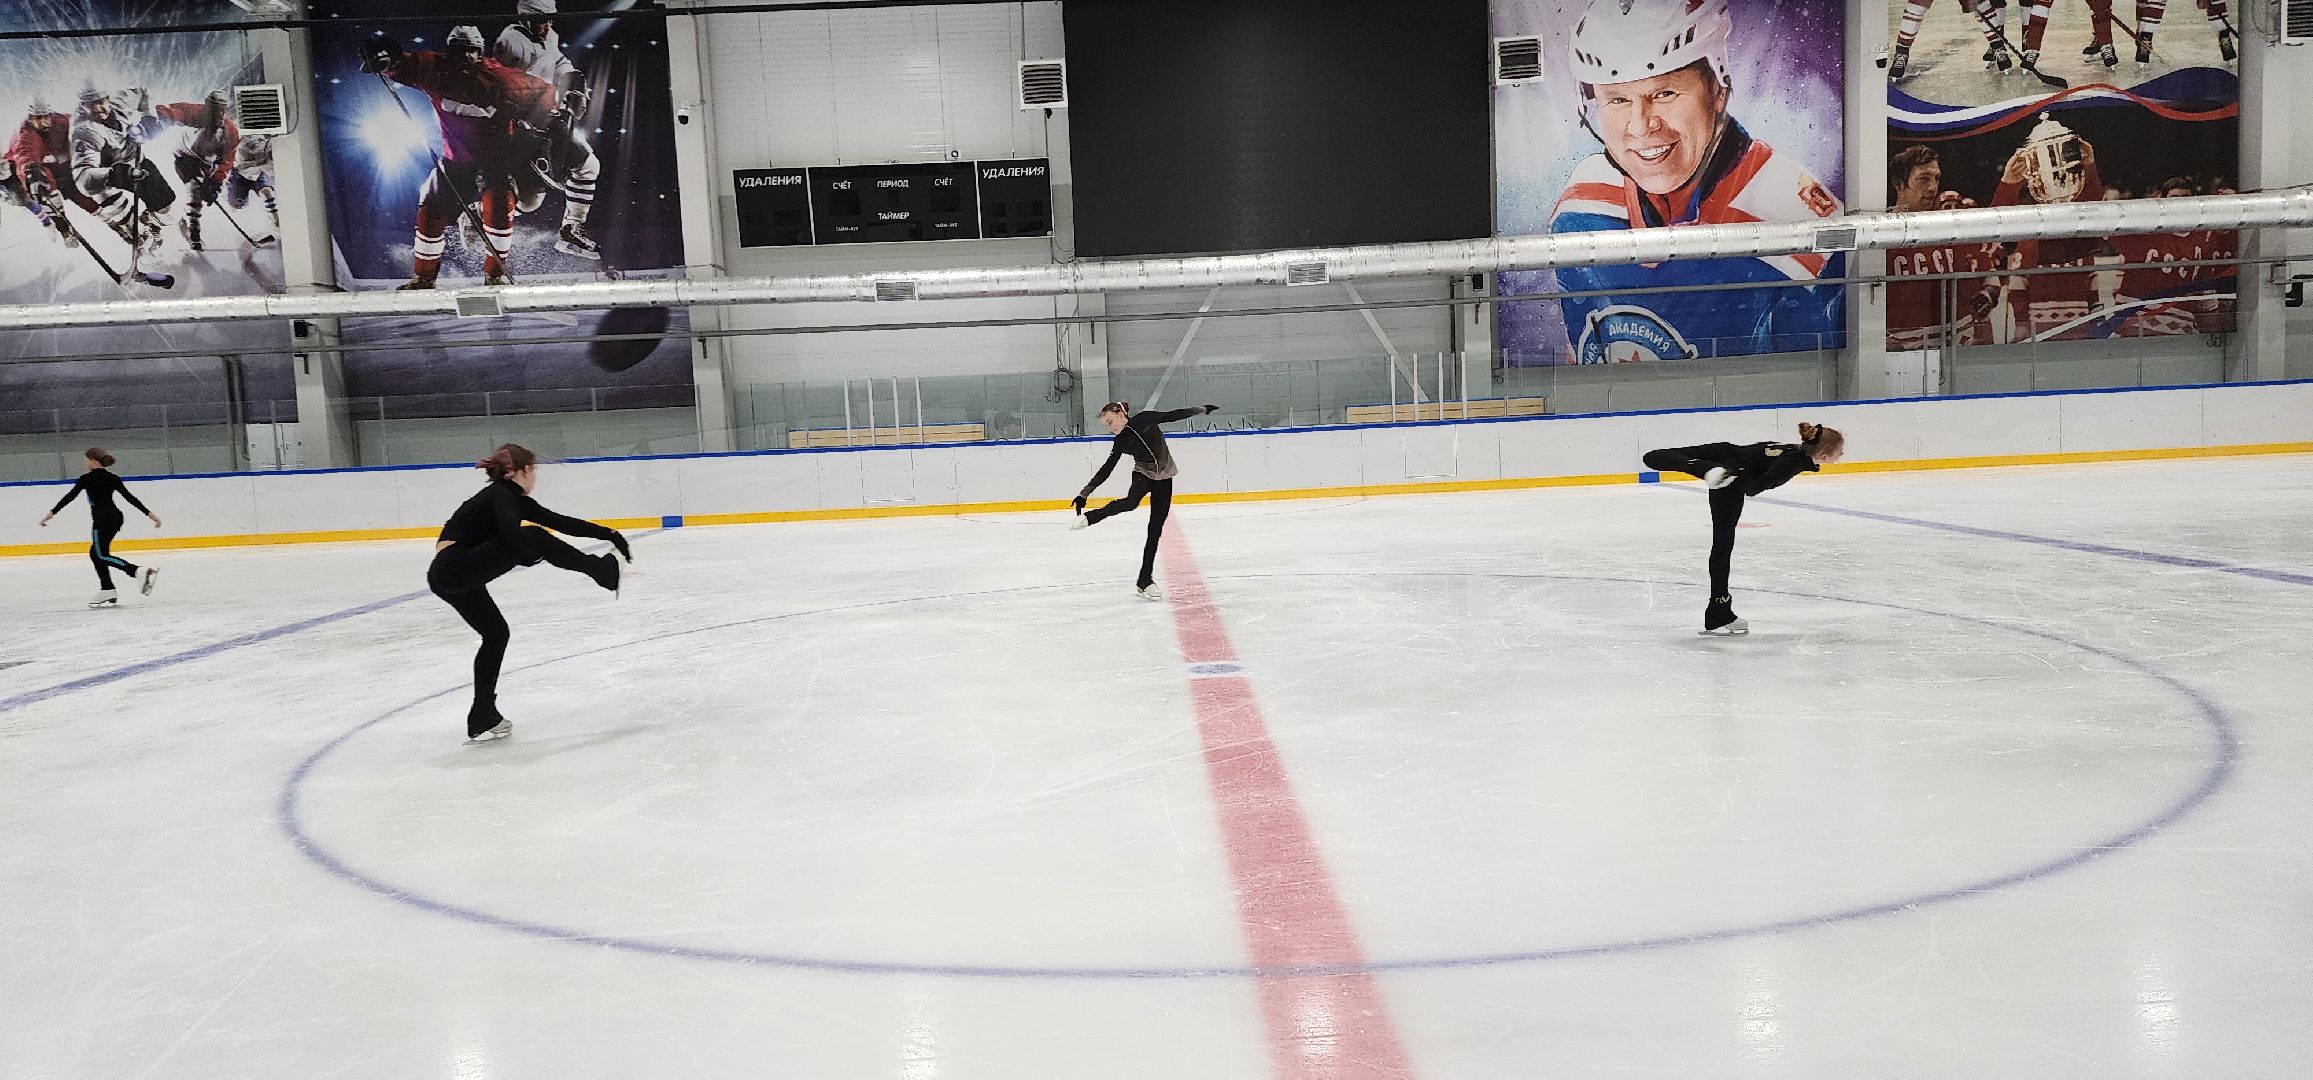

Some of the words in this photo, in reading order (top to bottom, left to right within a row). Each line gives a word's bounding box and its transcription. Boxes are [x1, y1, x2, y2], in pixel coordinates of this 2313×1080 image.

[982, 166, 1045, 179] УДАЛЕНИЯ
[739, 175, 802, 188] УДАЛЕНИЯ
[832, 179, 852, 190] СЧЁТ
[877, 179, 910, 188] ПЕРИОД
[934, 177, 953, 187] СЧЁТ
[877, 211, 910, 220] ТАЙМЕР
[1608, 322, 1671, 353] АКАДЕМИЯ
